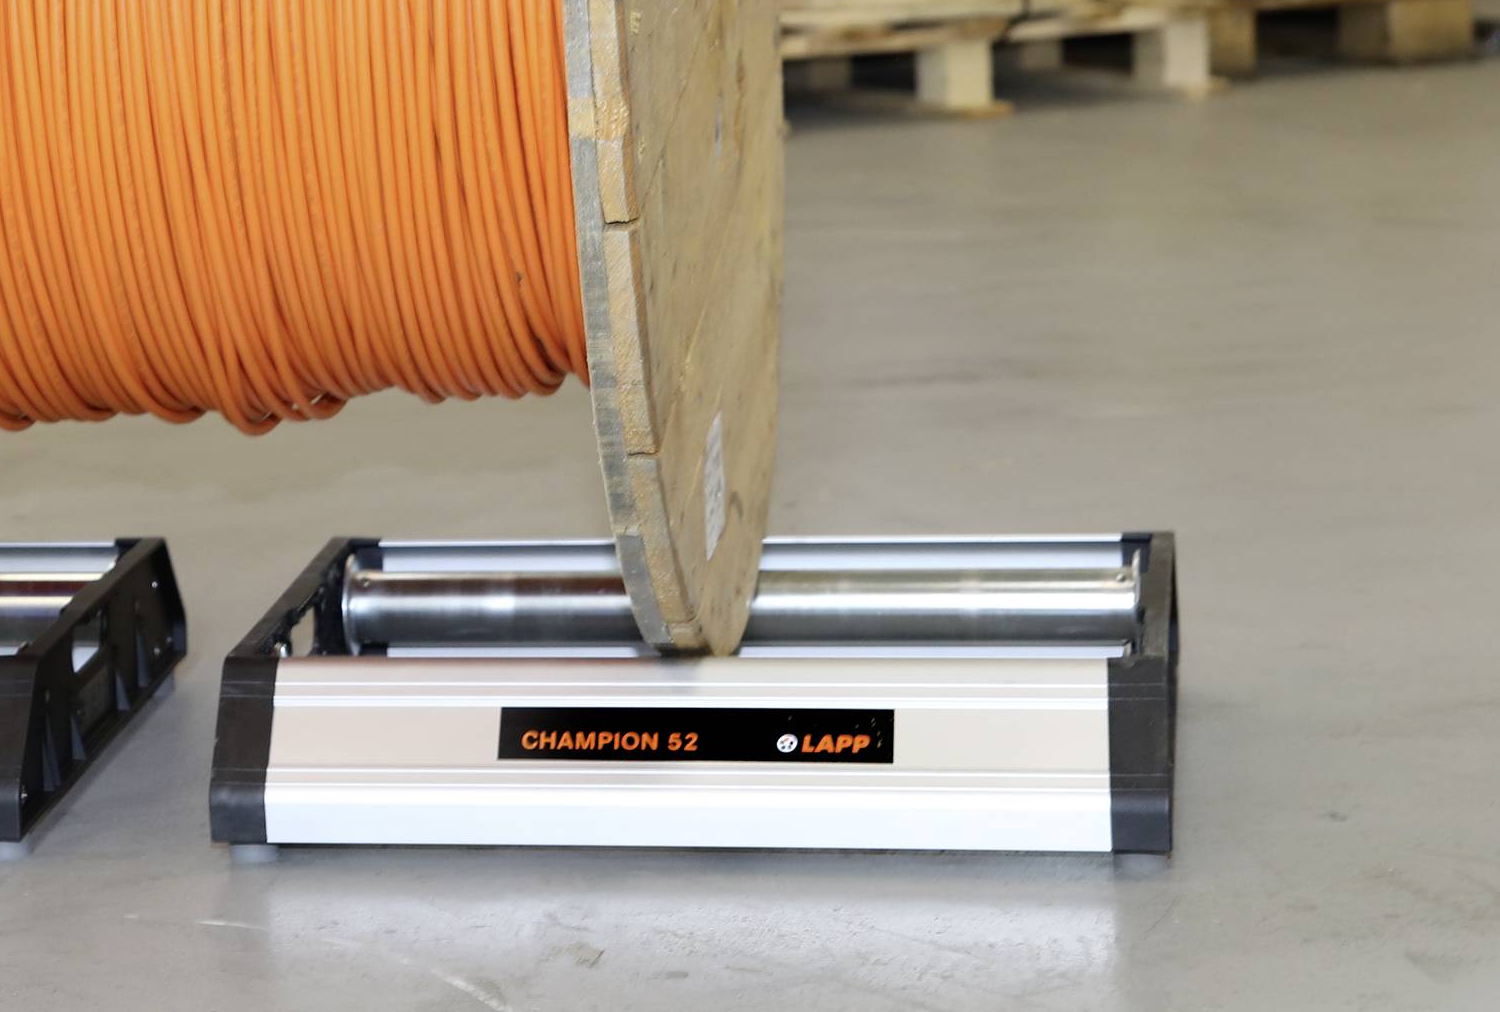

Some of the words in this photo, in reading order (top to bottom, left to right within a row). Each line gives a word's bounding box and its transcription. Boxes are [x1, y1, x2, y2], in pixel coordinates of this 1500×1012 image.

[521, 730, 658, 751] CHAMPION
[668, 732, 699, 751] 52
[801, 734, 871, 753] LAPP
